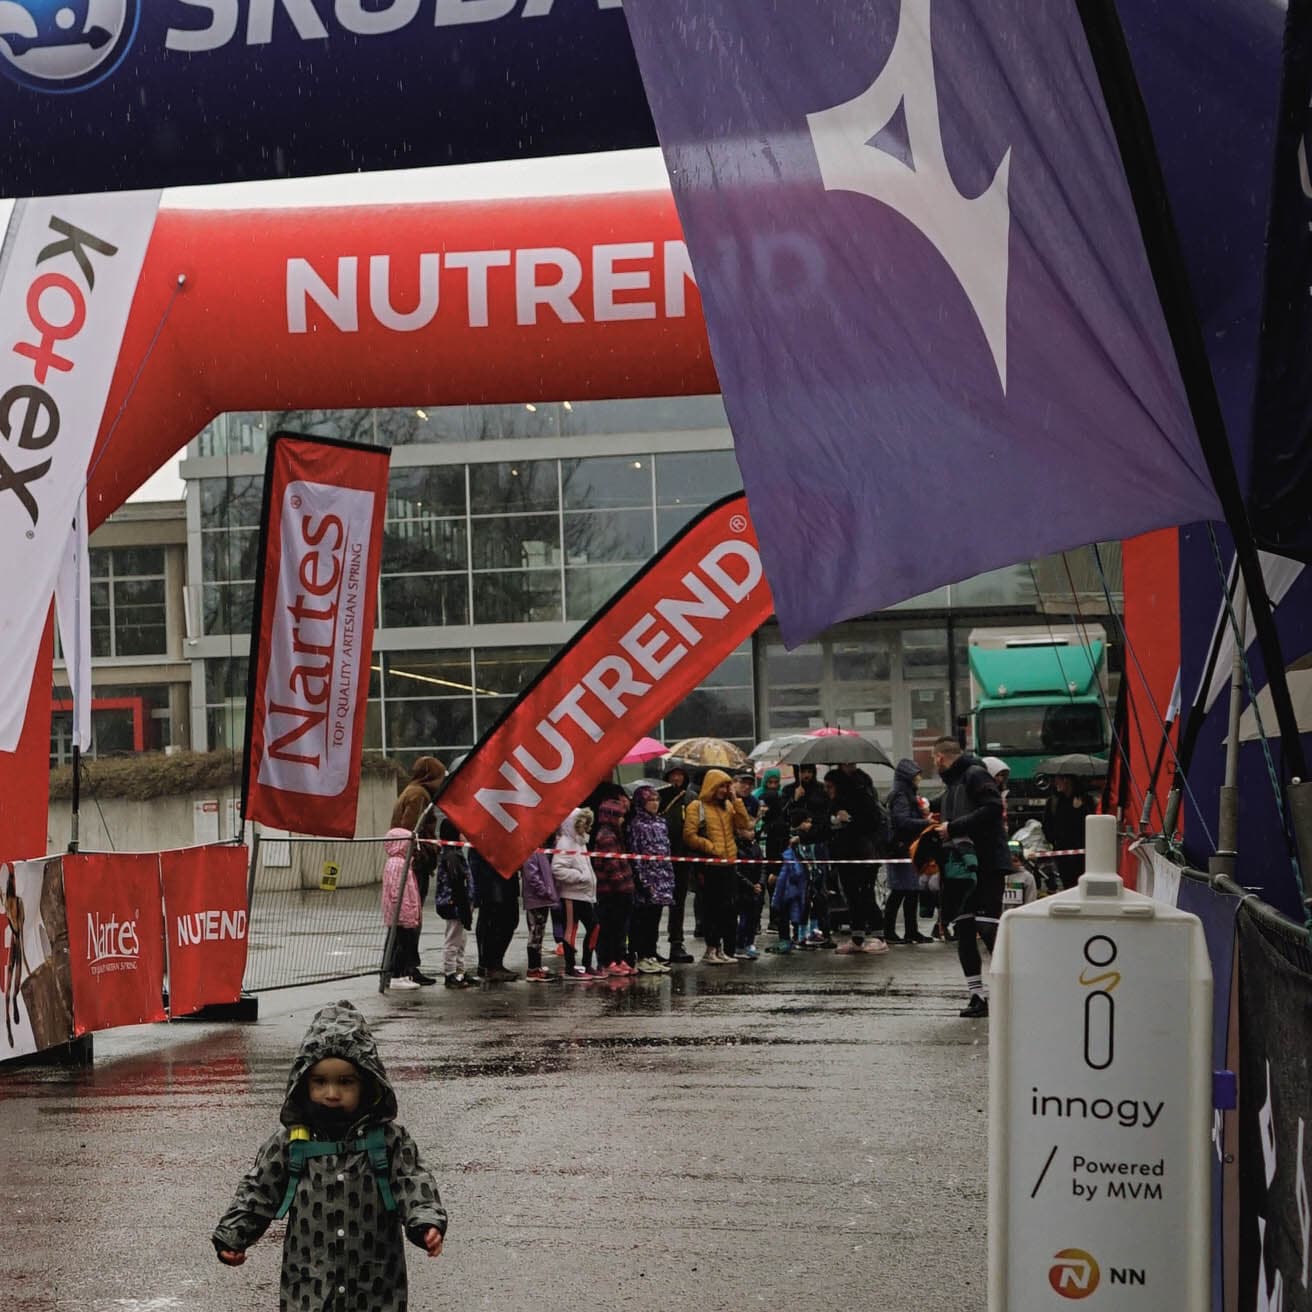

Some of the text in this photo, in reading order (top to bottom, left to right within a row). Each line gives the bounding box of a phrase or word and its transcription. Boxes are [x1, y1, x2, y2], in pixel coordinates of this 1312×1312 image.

[267, 513, 344, 770] Nartes
[333, 543, 362, 748] TOP QUALITY ARTESIAN SPRING
[474, 540, 763, 832] NUTREND
[87, 911, 139, 959] Nartes
[1032, 1087, 1164, 1128] innogy
[1072, 1156, 1164, 1176] Powered
[1072, 1179, 1163, 1201] by MVM
[1110, 1267, 1146, 1285] NN
